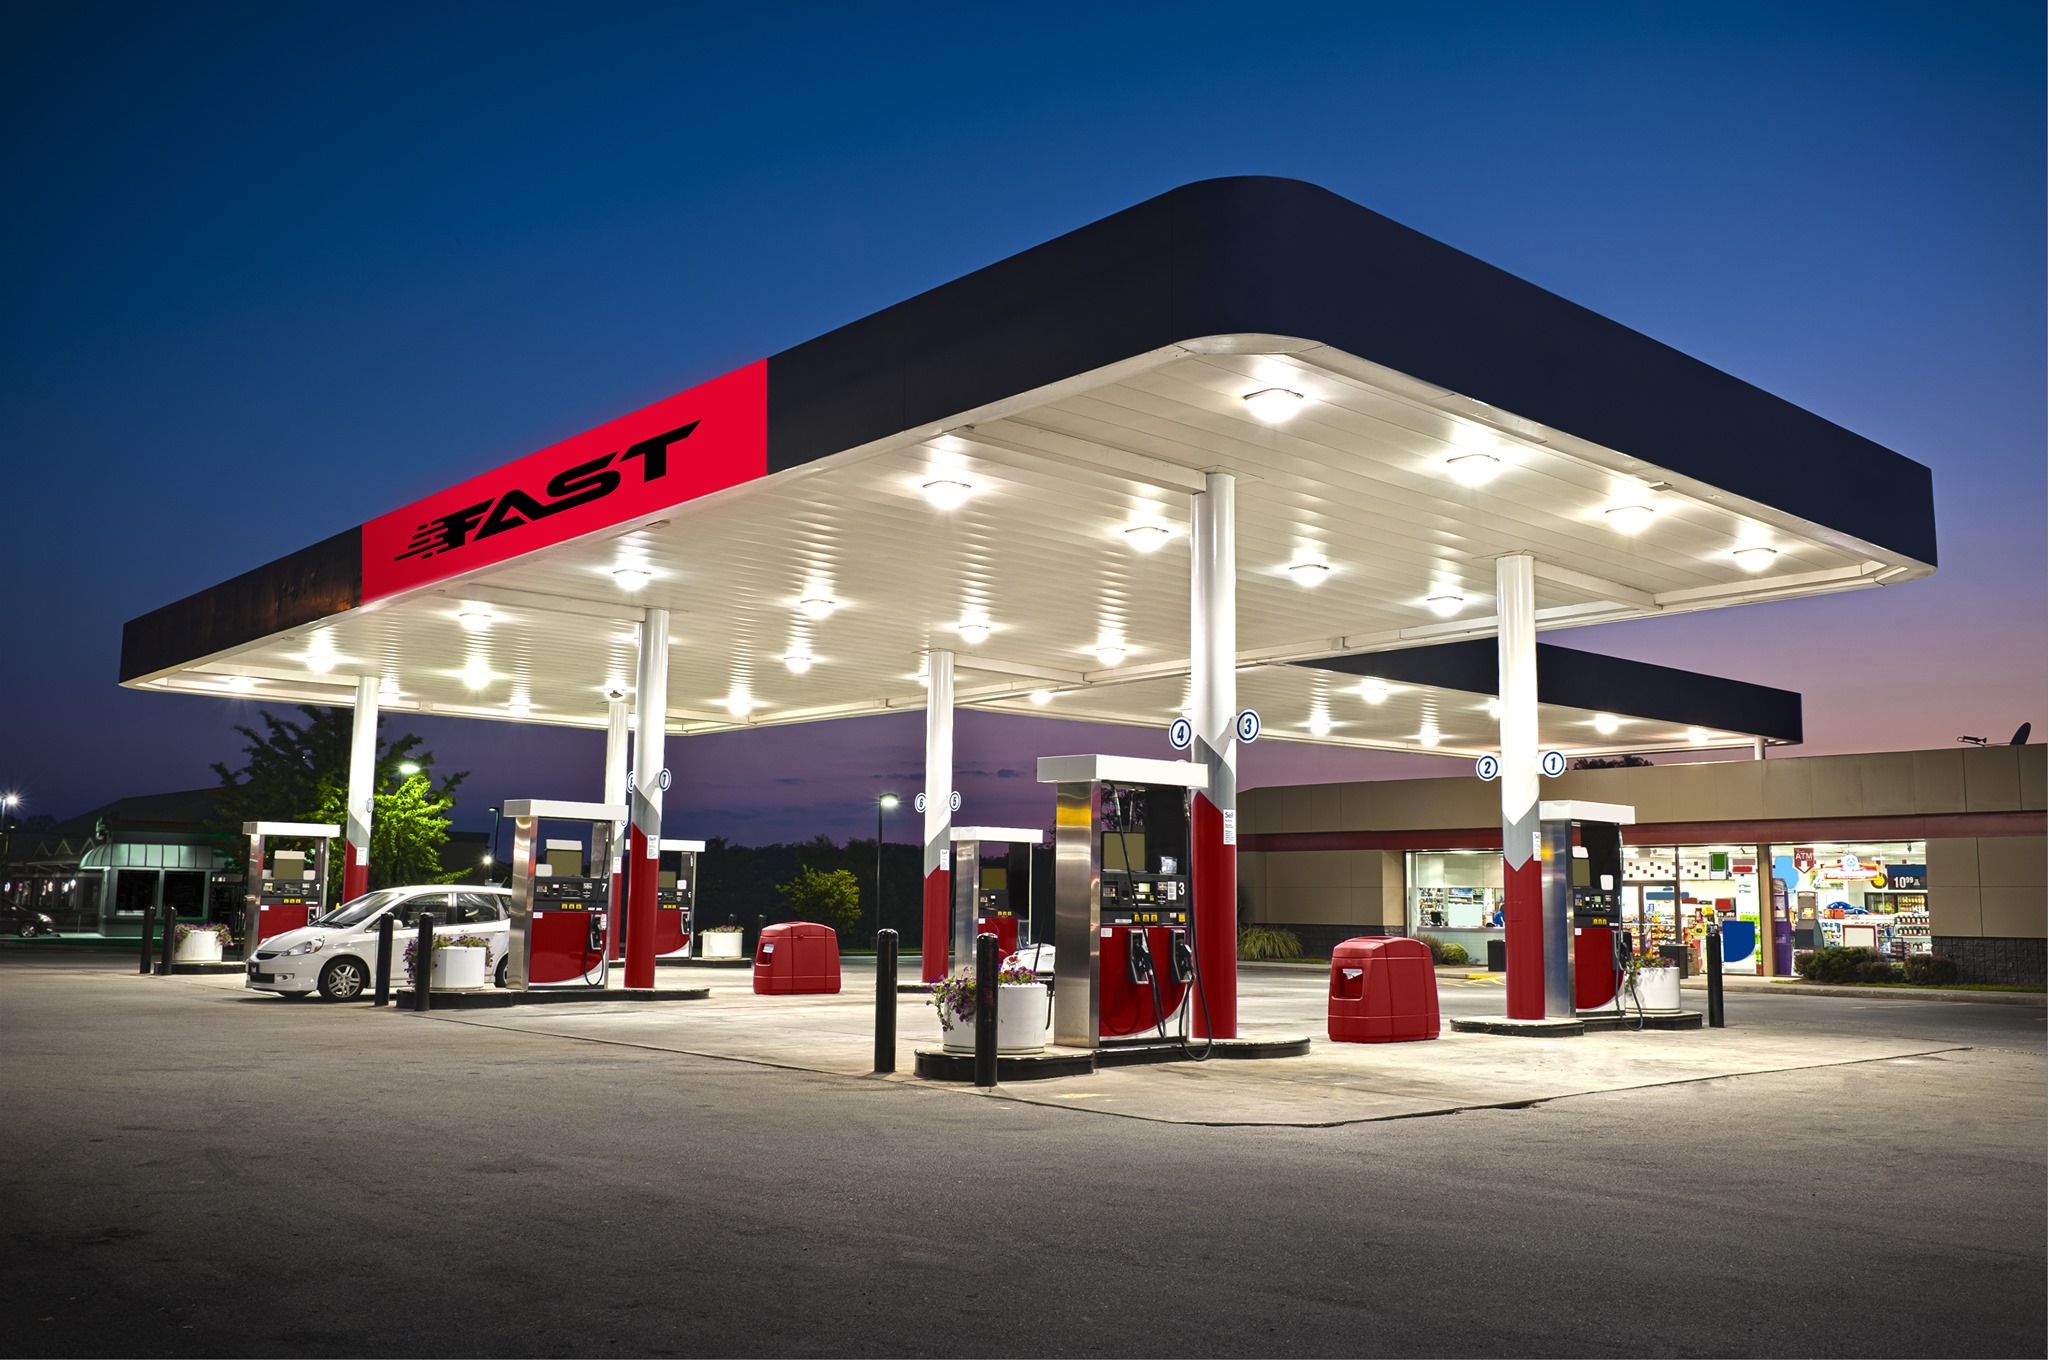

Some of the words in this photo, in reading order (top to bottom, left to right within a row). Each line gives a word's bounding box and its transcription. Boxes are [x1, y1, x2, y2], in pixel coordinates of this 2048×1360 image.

[412, 418, 702, 555] FAST
[1244, 718, 1252, 735] 3
[1177, 726, 1185, 741] 4
[1484, 761, 1491, 774] 2
[1550, 757, 1556, 771] 1
[662, 774, 667, 786] 7
[919, 798, 924, 808] 6
[952, 796, 957, 807] 5
[601, 883, 607, 892] 7
[1178, 882, 1185, 895] 3
